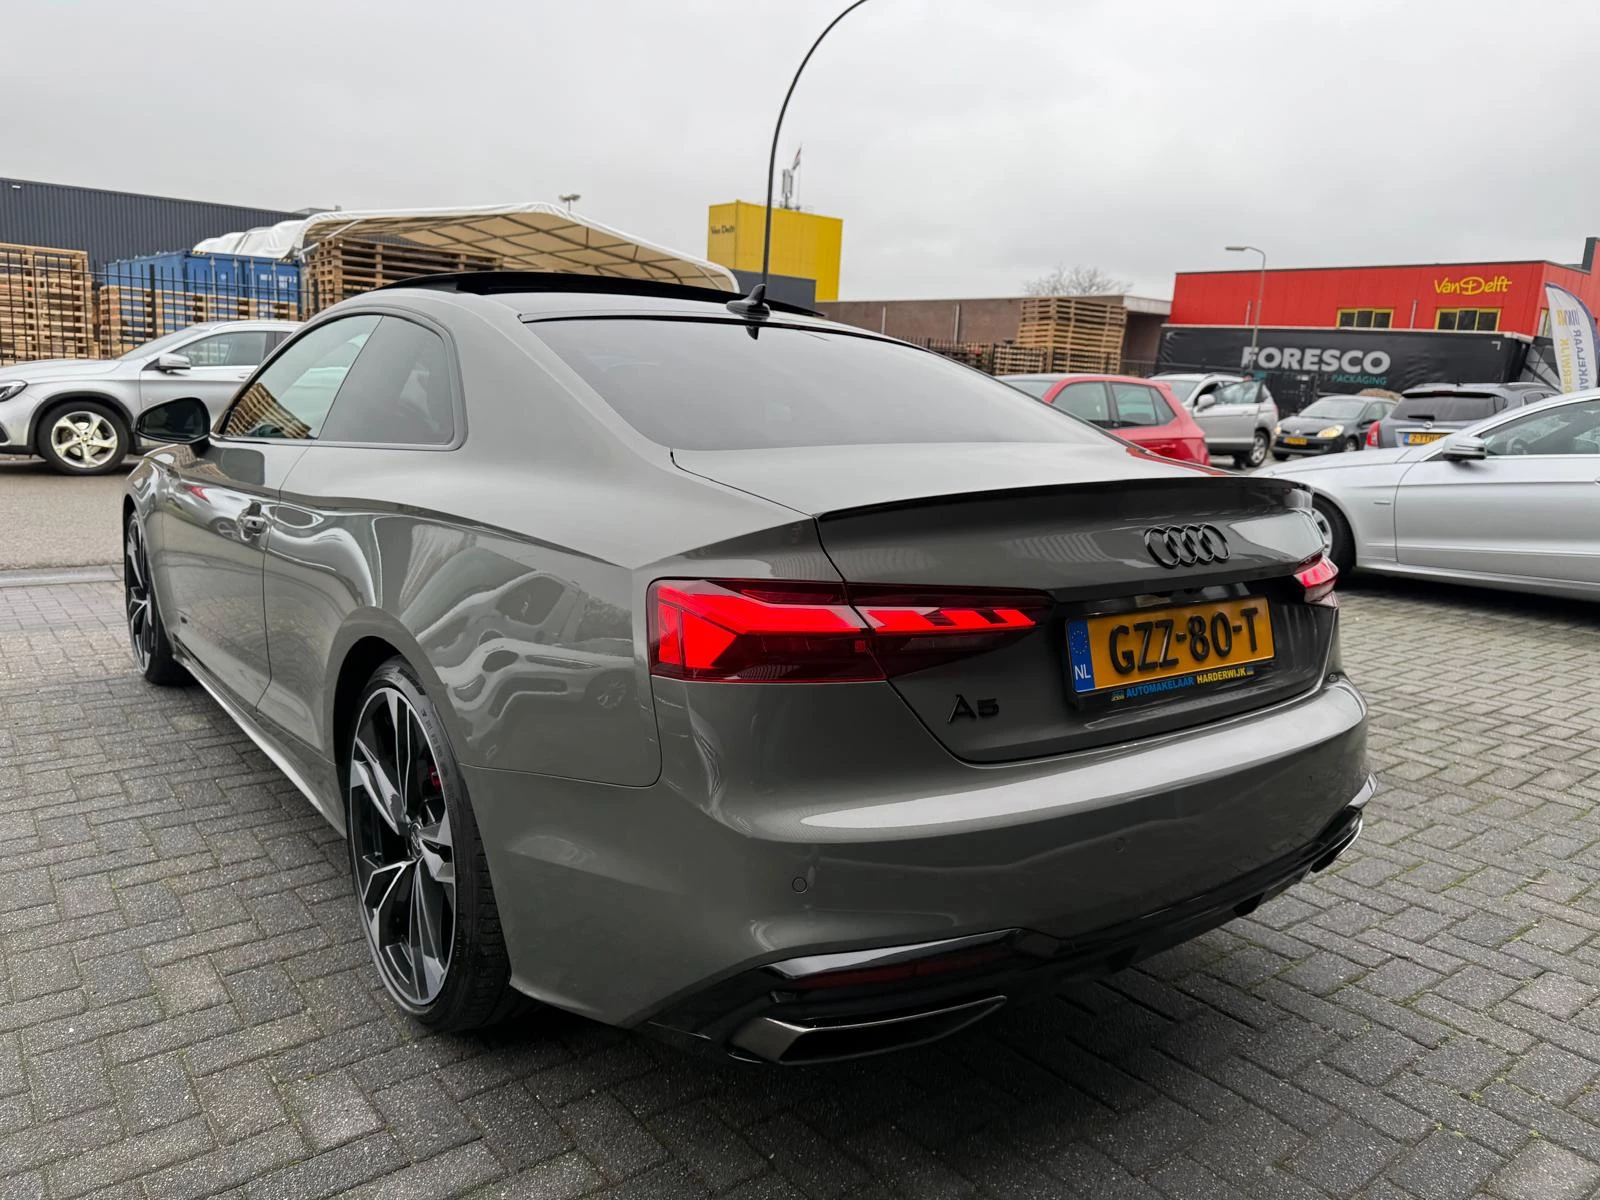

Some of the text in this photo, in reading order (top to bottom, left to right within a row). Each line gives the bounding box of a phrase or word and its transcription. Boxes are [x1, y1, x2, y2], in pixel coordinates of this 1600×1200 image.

[1241, 346, 1391, 374] FORESCO
[1332, 374, 1387, 386] PACKAGING
[1109, 607, 1259, 675] GZZ-80-T
[1074, 666, 1092, 681] NL
[1126, 667, 1247, 698] AUTOMAKELAAR HARDERWIJK
[947, 694, 999, 724] A5
